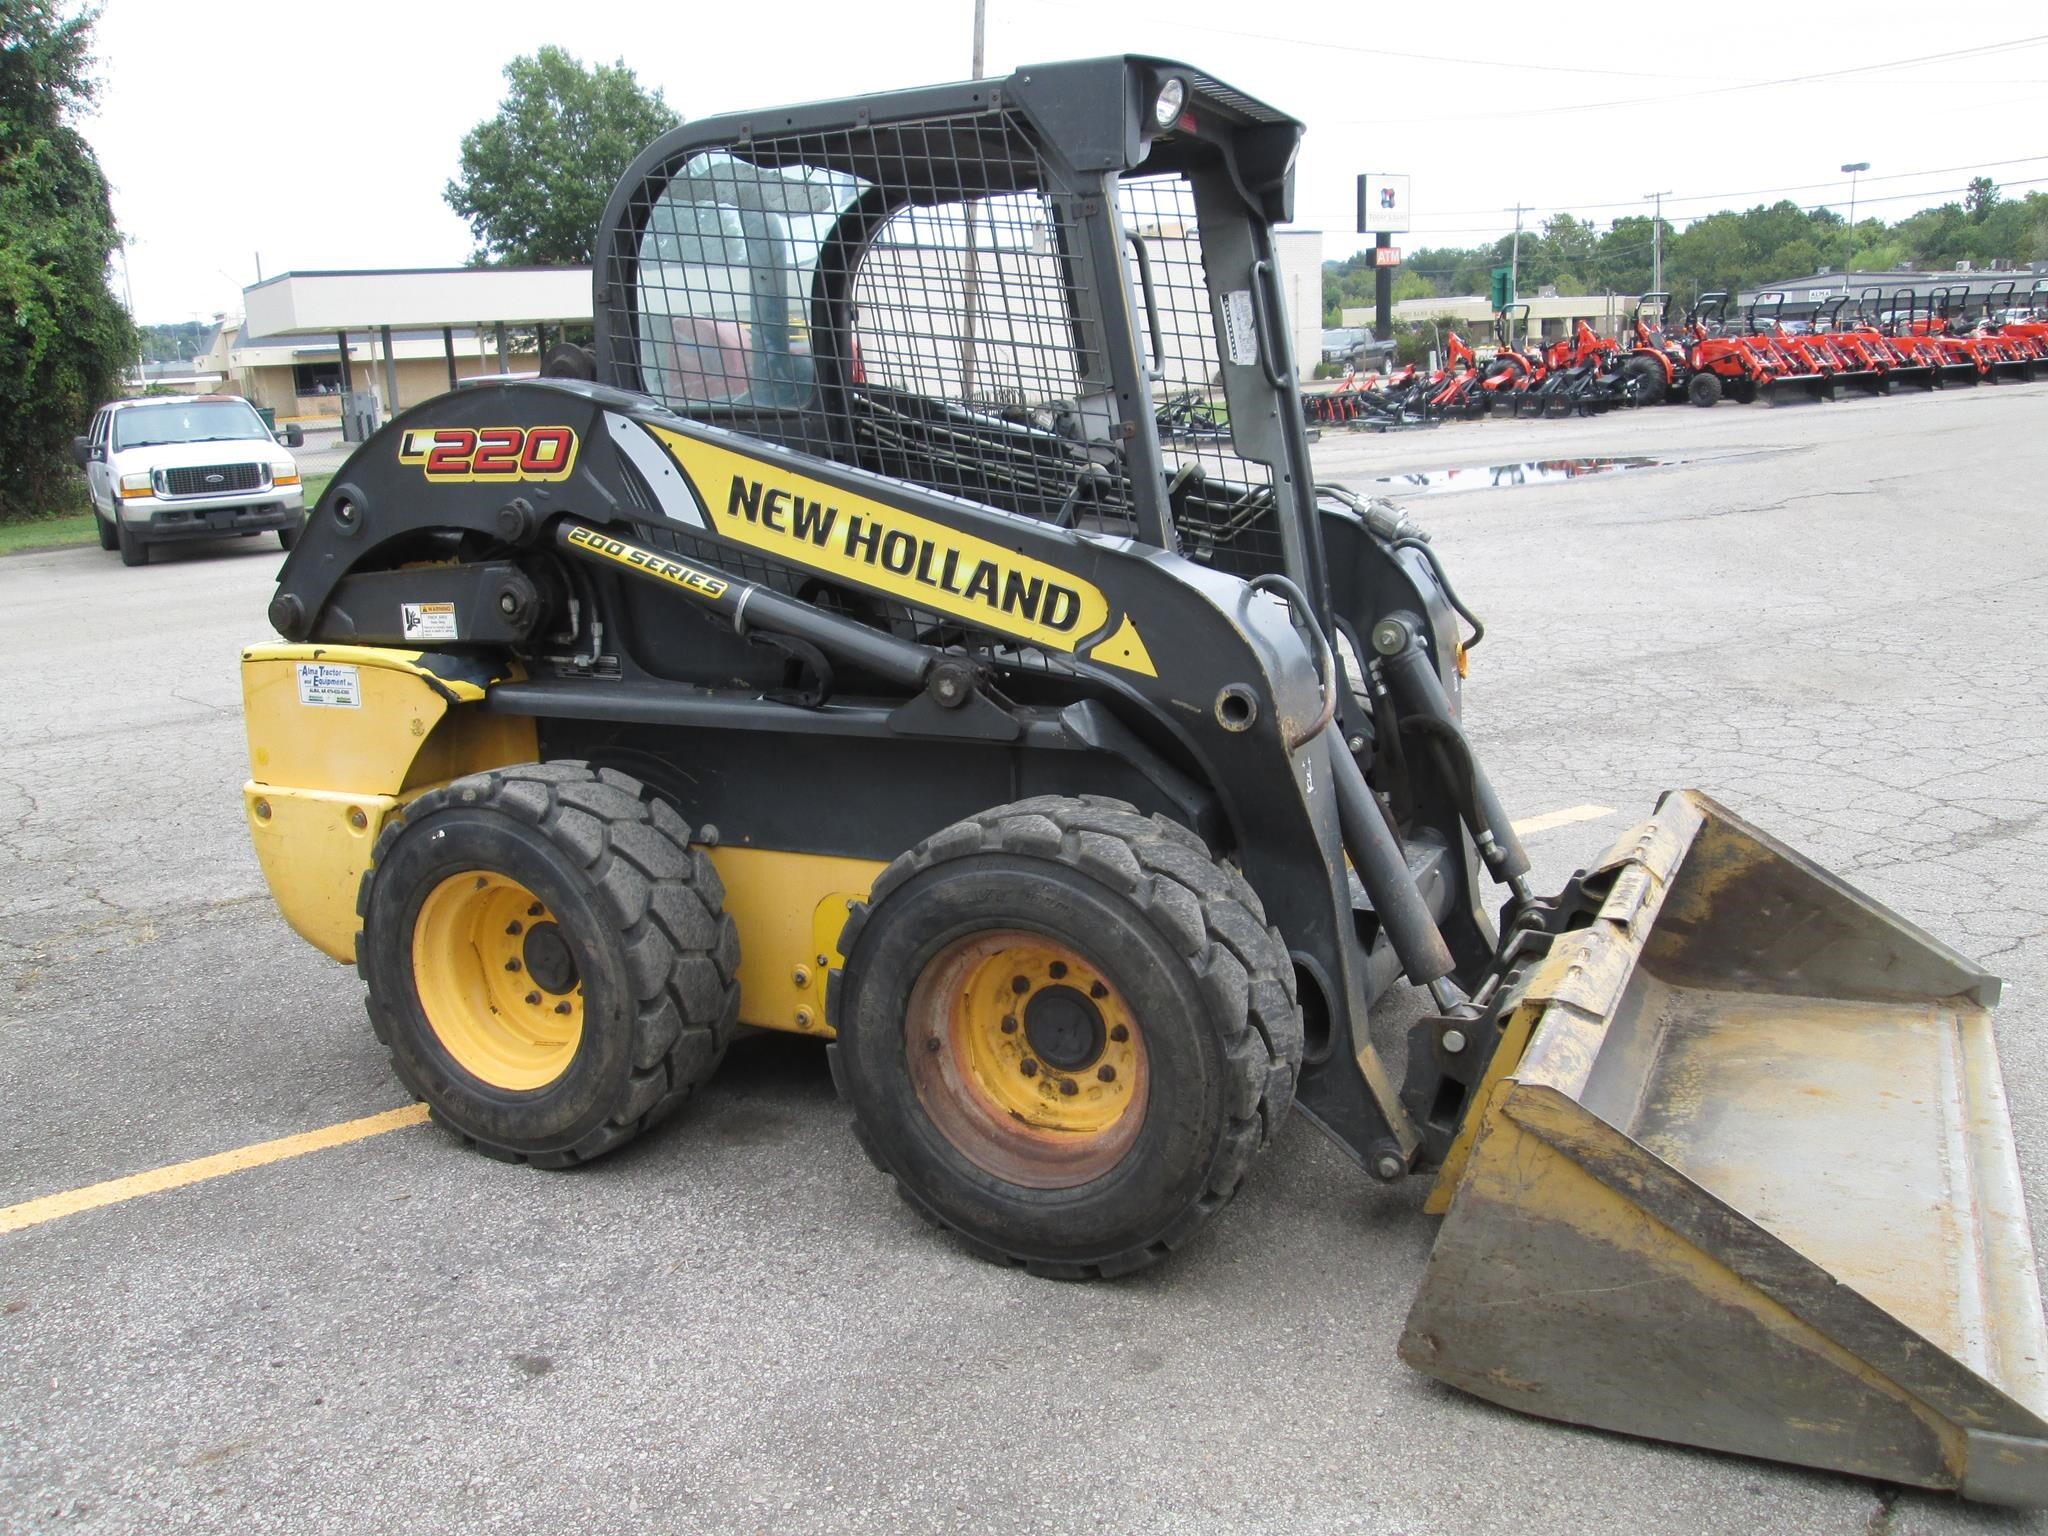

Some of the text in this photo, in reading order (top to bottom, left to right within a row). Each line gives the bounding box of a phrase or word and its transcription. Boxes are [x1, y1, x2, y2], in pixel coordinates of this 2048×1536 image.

[1377, 250, 1400, 263] ATM
[401, 427, 575, 475] L220
[569, 527, 725, 595] 200 SERIES
[727, 473, 1082, 632] NEW HOLLAND
[302, 665, 342, 677] Alma Tractor
[313, 676, 346, 686] Equipment
